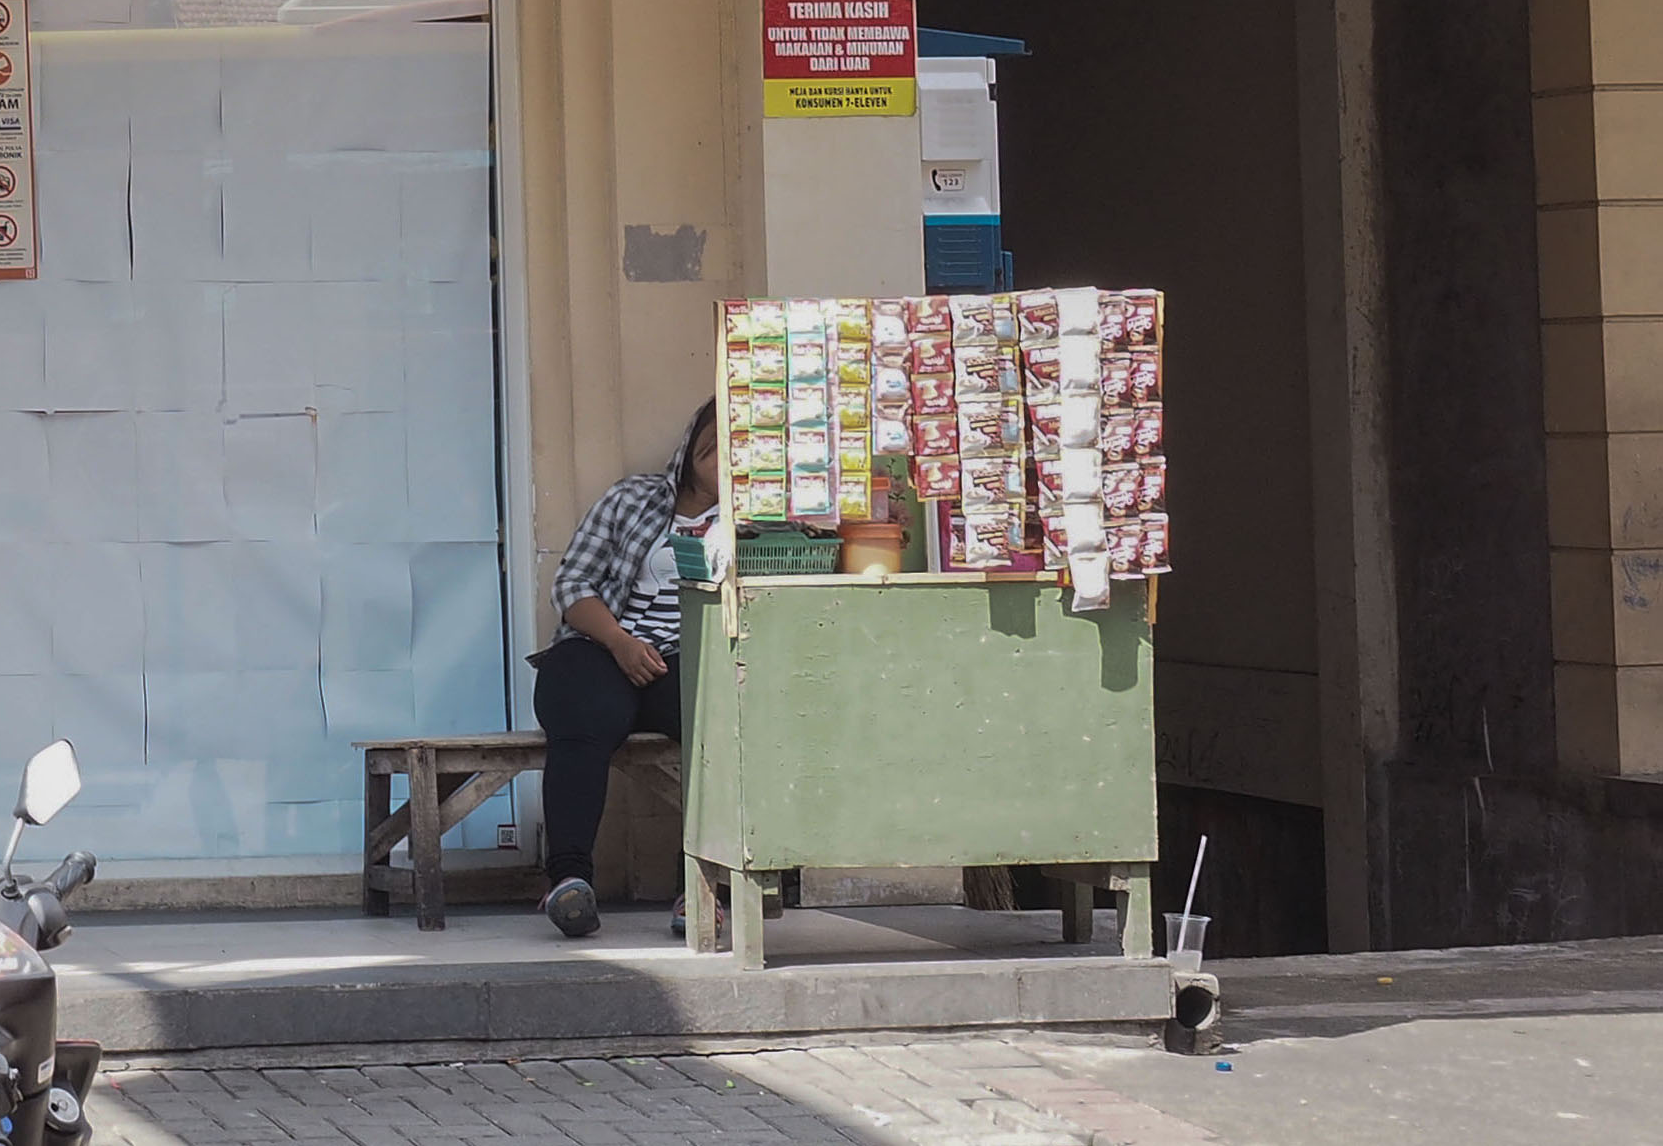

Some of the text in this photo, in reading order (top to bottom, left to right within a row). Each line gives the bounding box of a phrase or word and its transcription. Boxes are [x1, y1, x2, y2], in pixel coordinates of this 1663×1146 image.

[788, 1, 889, 19] TERIMA KASIH
[768, 26, 910, 41] UNTUK TIDAK MEMBAWA
[775, 41, 904, 56] MAKANAN & MINUMAN
[810, 57, 871, 71] DARI LUAR
[789, 87, 807, 96] MEJA
[796, 97, 888, 108] KONSUMEN 7-ELEVEN
